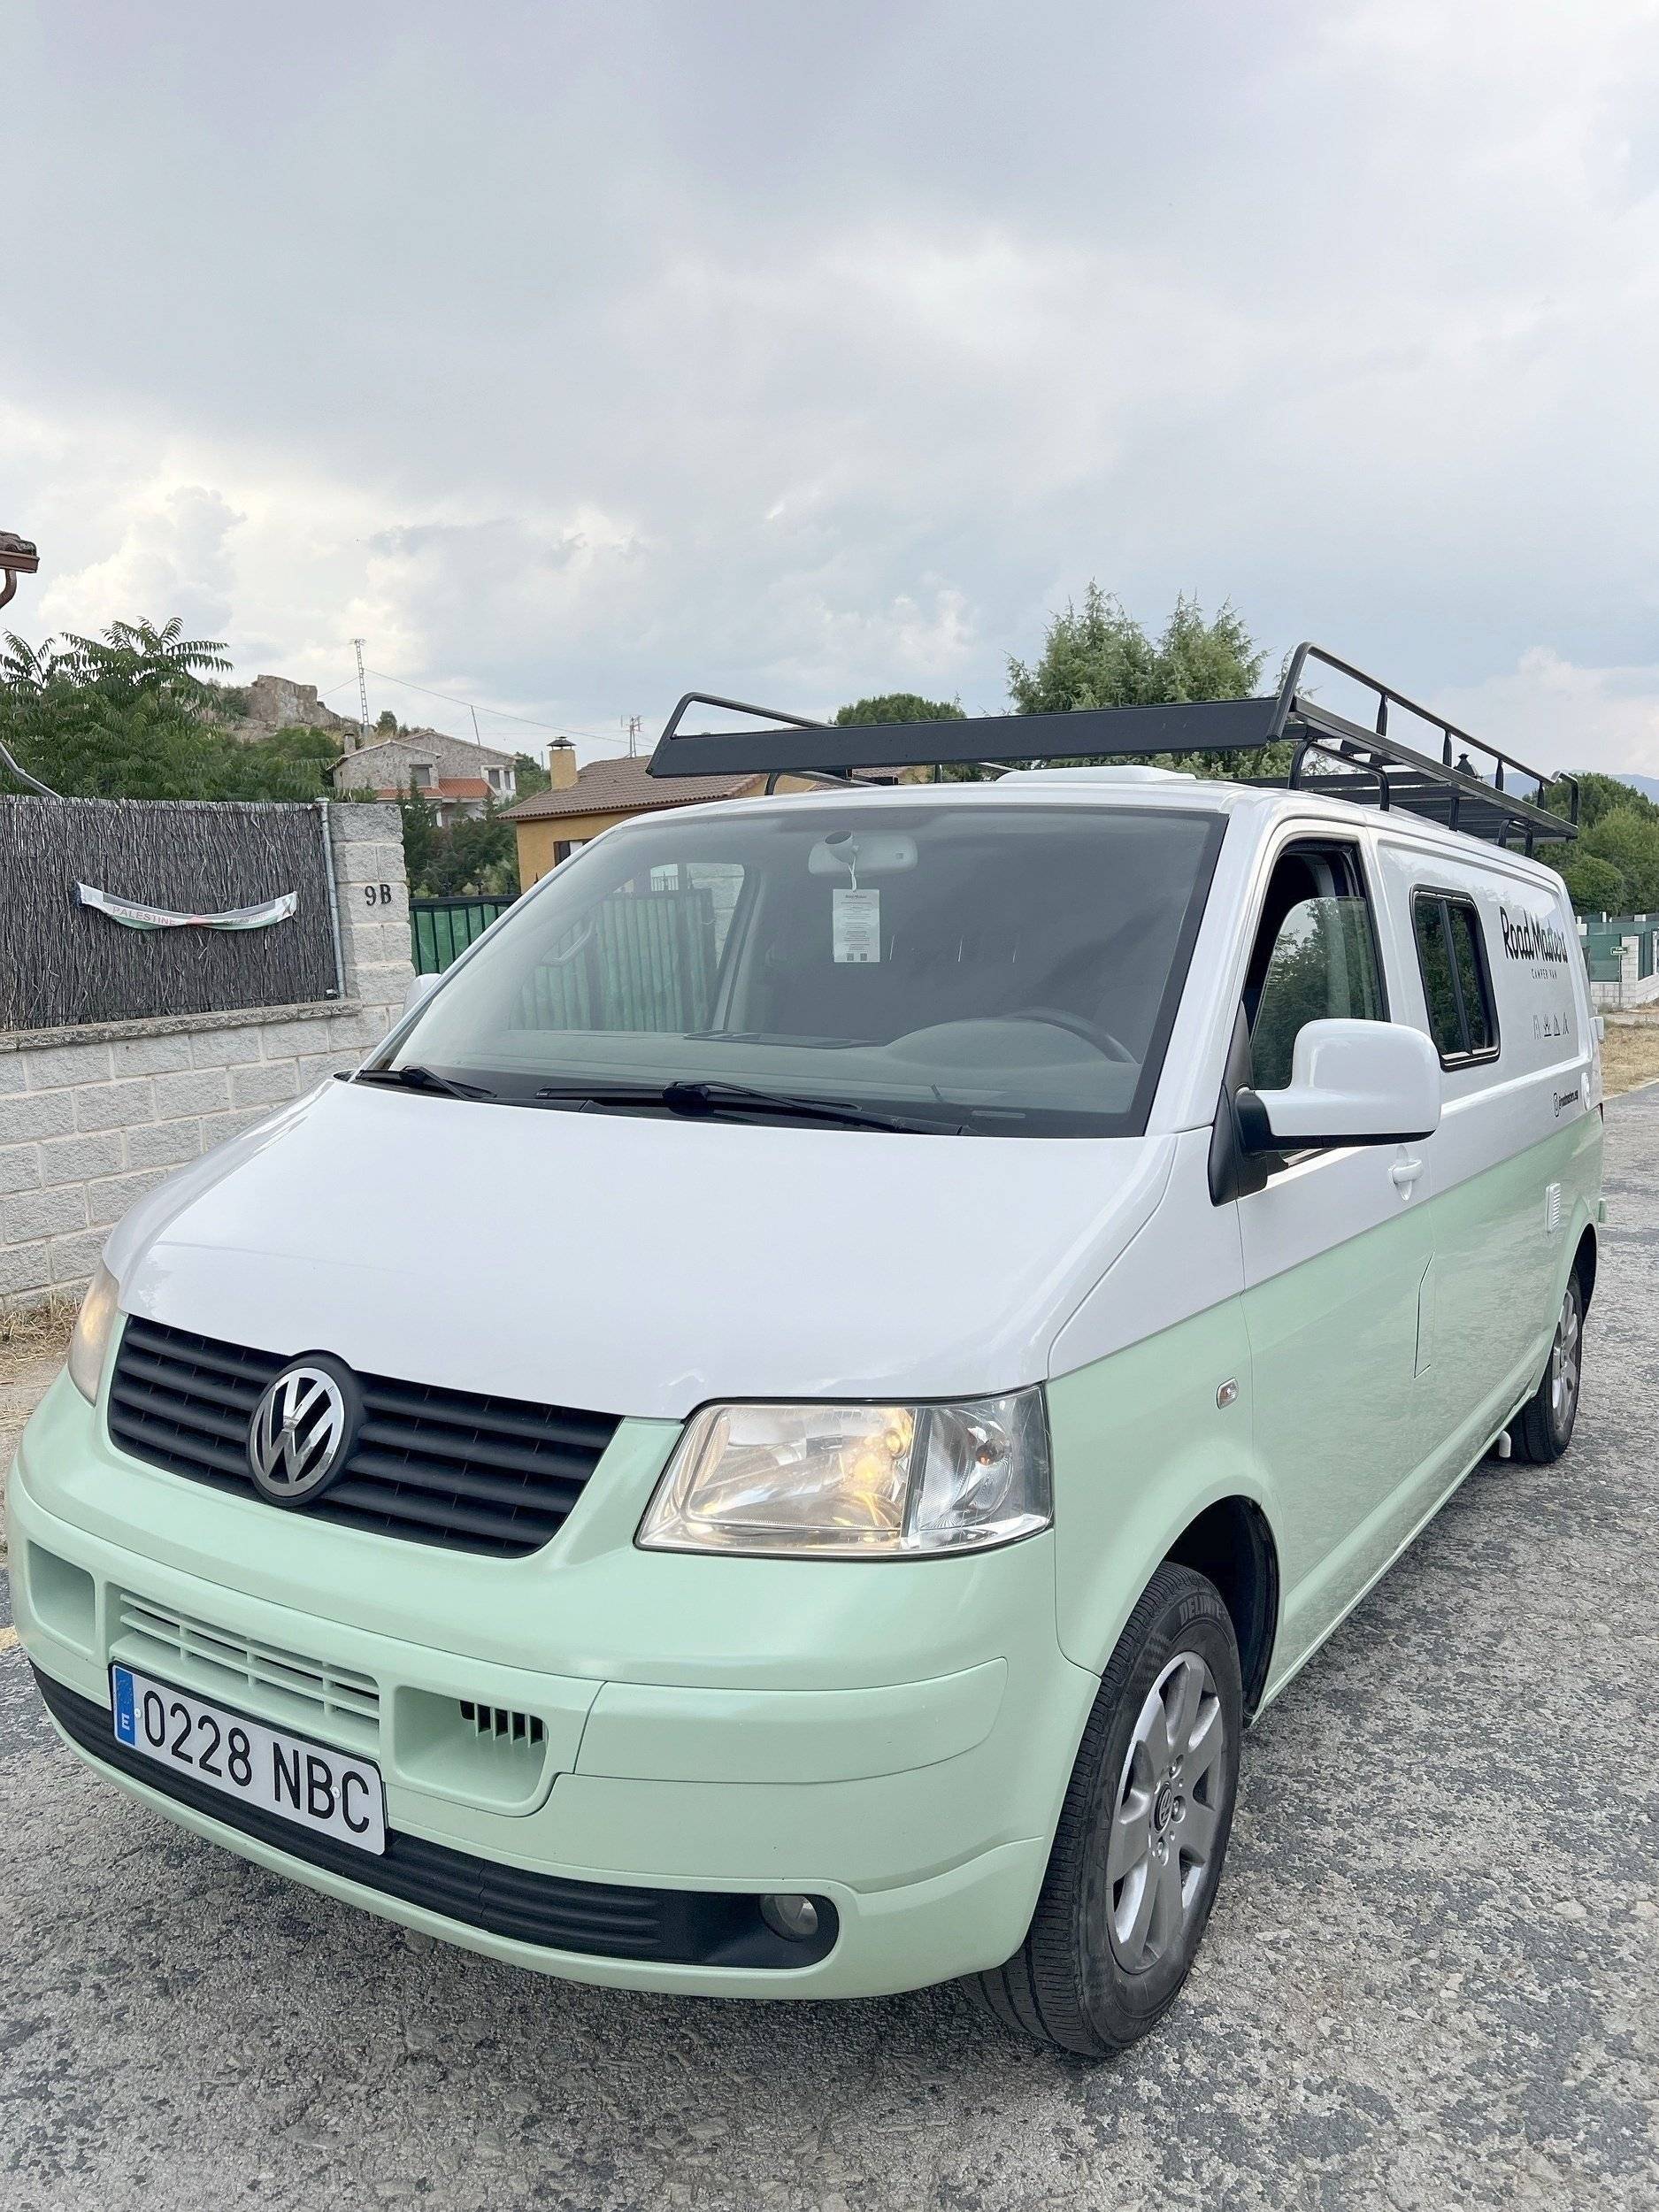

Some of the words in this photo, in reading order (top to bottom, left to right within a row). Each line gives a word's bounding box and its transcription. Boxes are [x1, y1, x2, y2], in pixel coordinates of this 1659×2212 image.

[364, 883, 393, 906] 9B
[111, 906, 176, 926] PALESTINE
[121, 1713, 130, 1731] E
[143, 1690, 252, 1787] 0228
[273, 1741, 371, 1833] NBC
